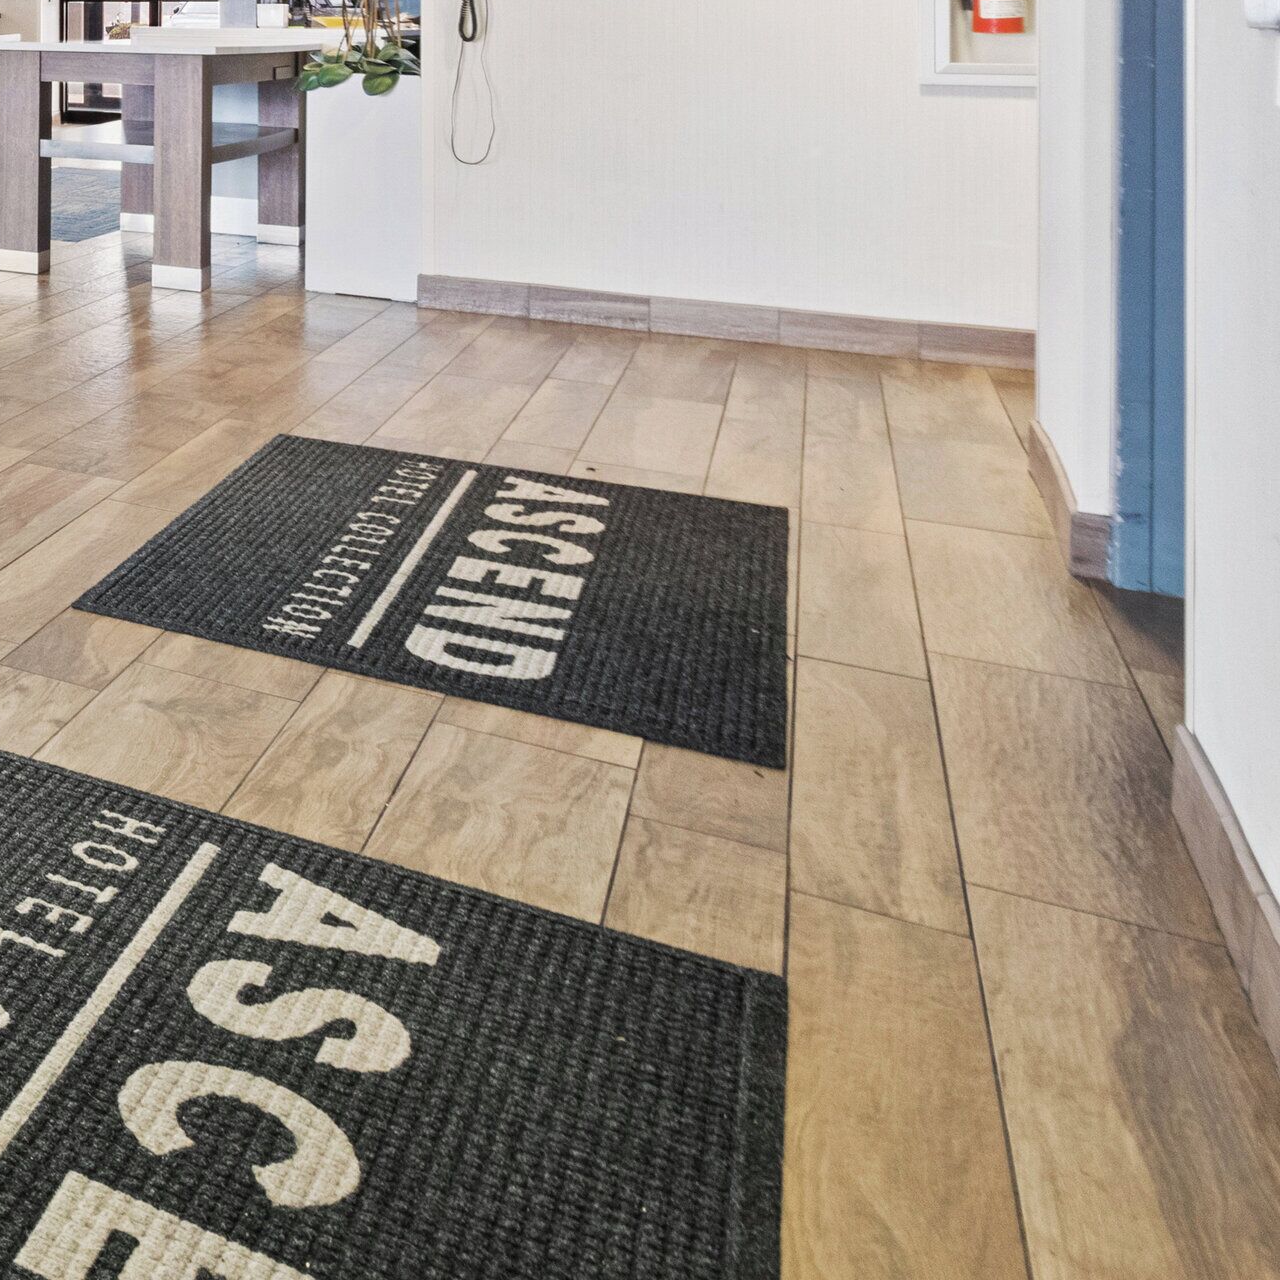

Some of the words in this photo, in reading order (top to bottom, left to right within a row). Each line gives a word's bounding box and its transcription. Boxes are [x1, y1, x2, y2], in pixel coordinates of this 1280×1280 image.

[370, 459, 444, 506] HOTEL
[262, 511, 401, 639] COLLECTION
[405, 476, 610, 680] ASCEND
